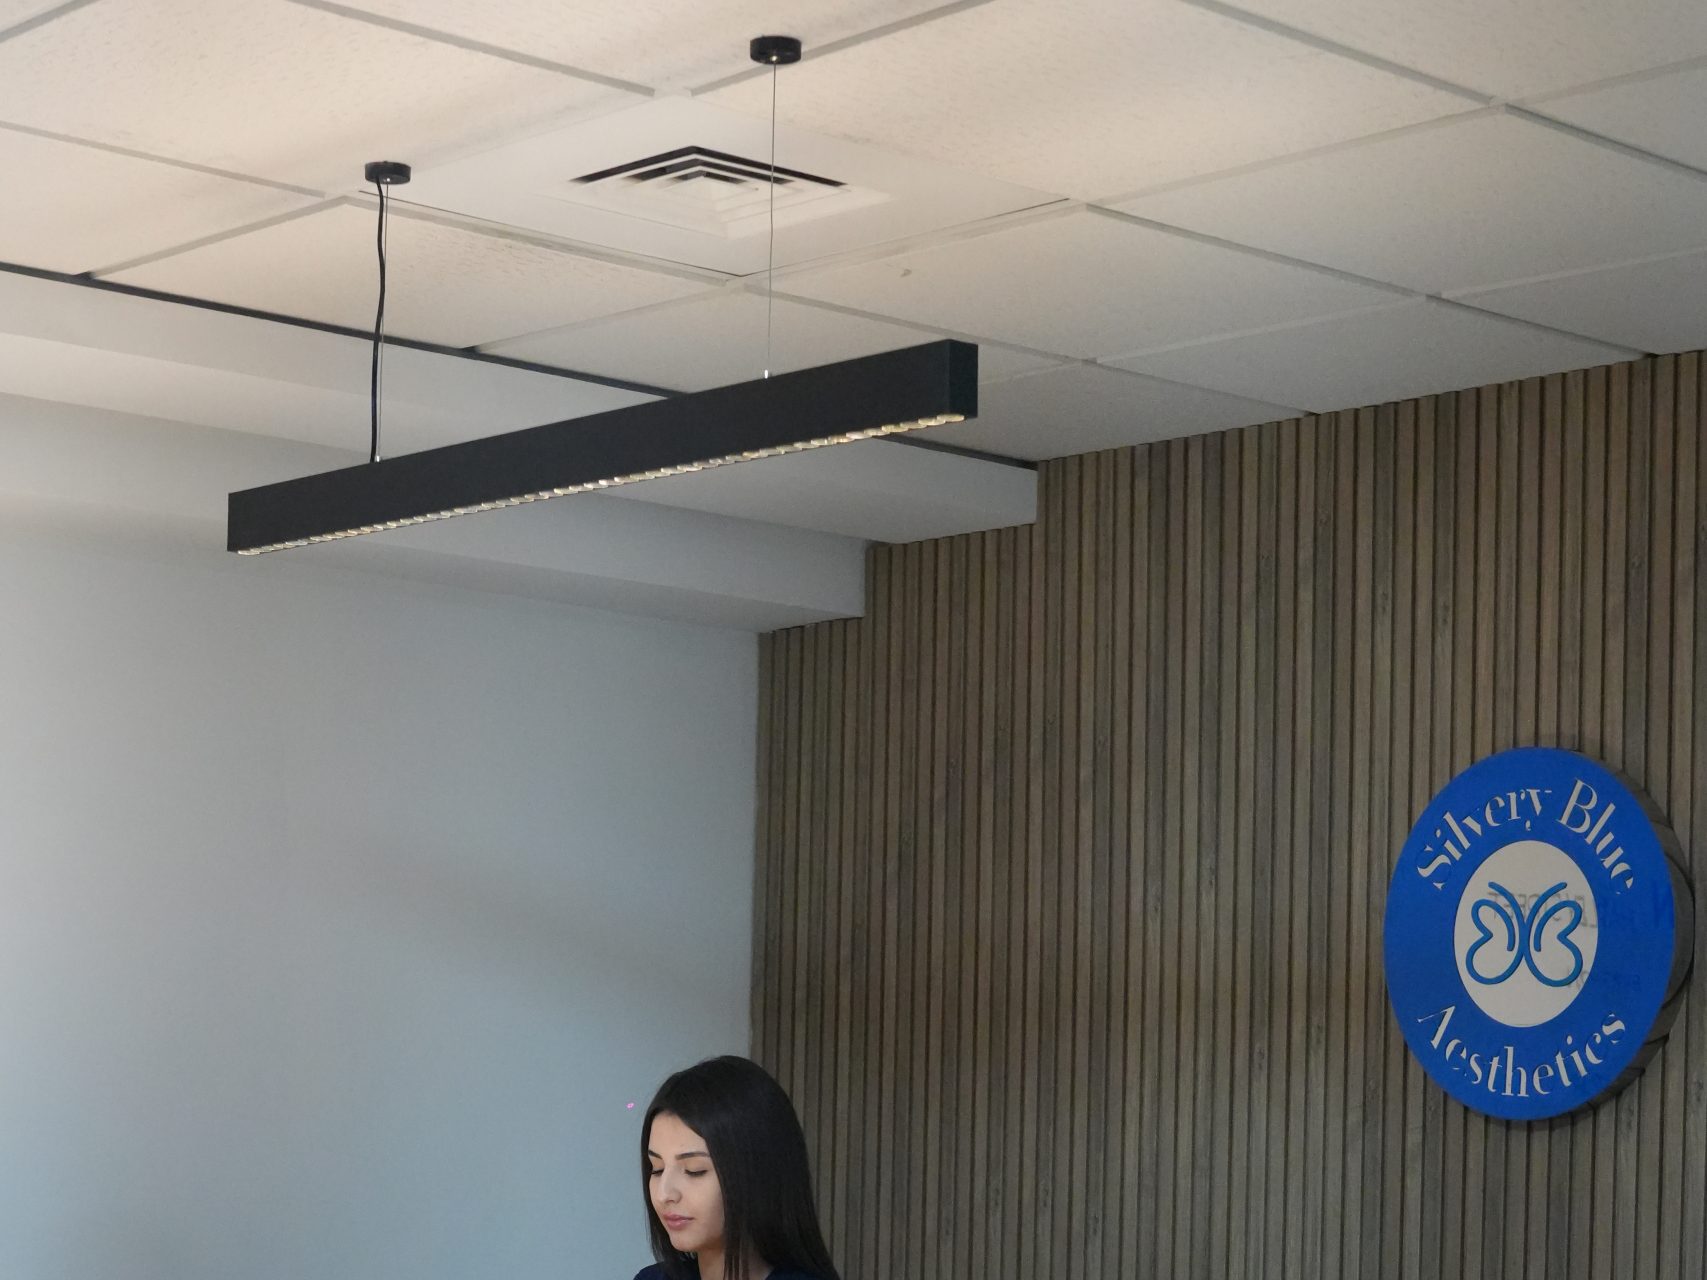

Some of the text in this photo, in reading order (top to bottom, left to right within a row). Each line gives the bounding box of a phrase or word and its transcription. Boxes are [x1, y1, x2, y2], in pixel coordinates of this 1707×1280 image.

[1416, 778, 1635, 894] Silvery Blue
[1416, 1005, 1627, 1097] Aesthetics
